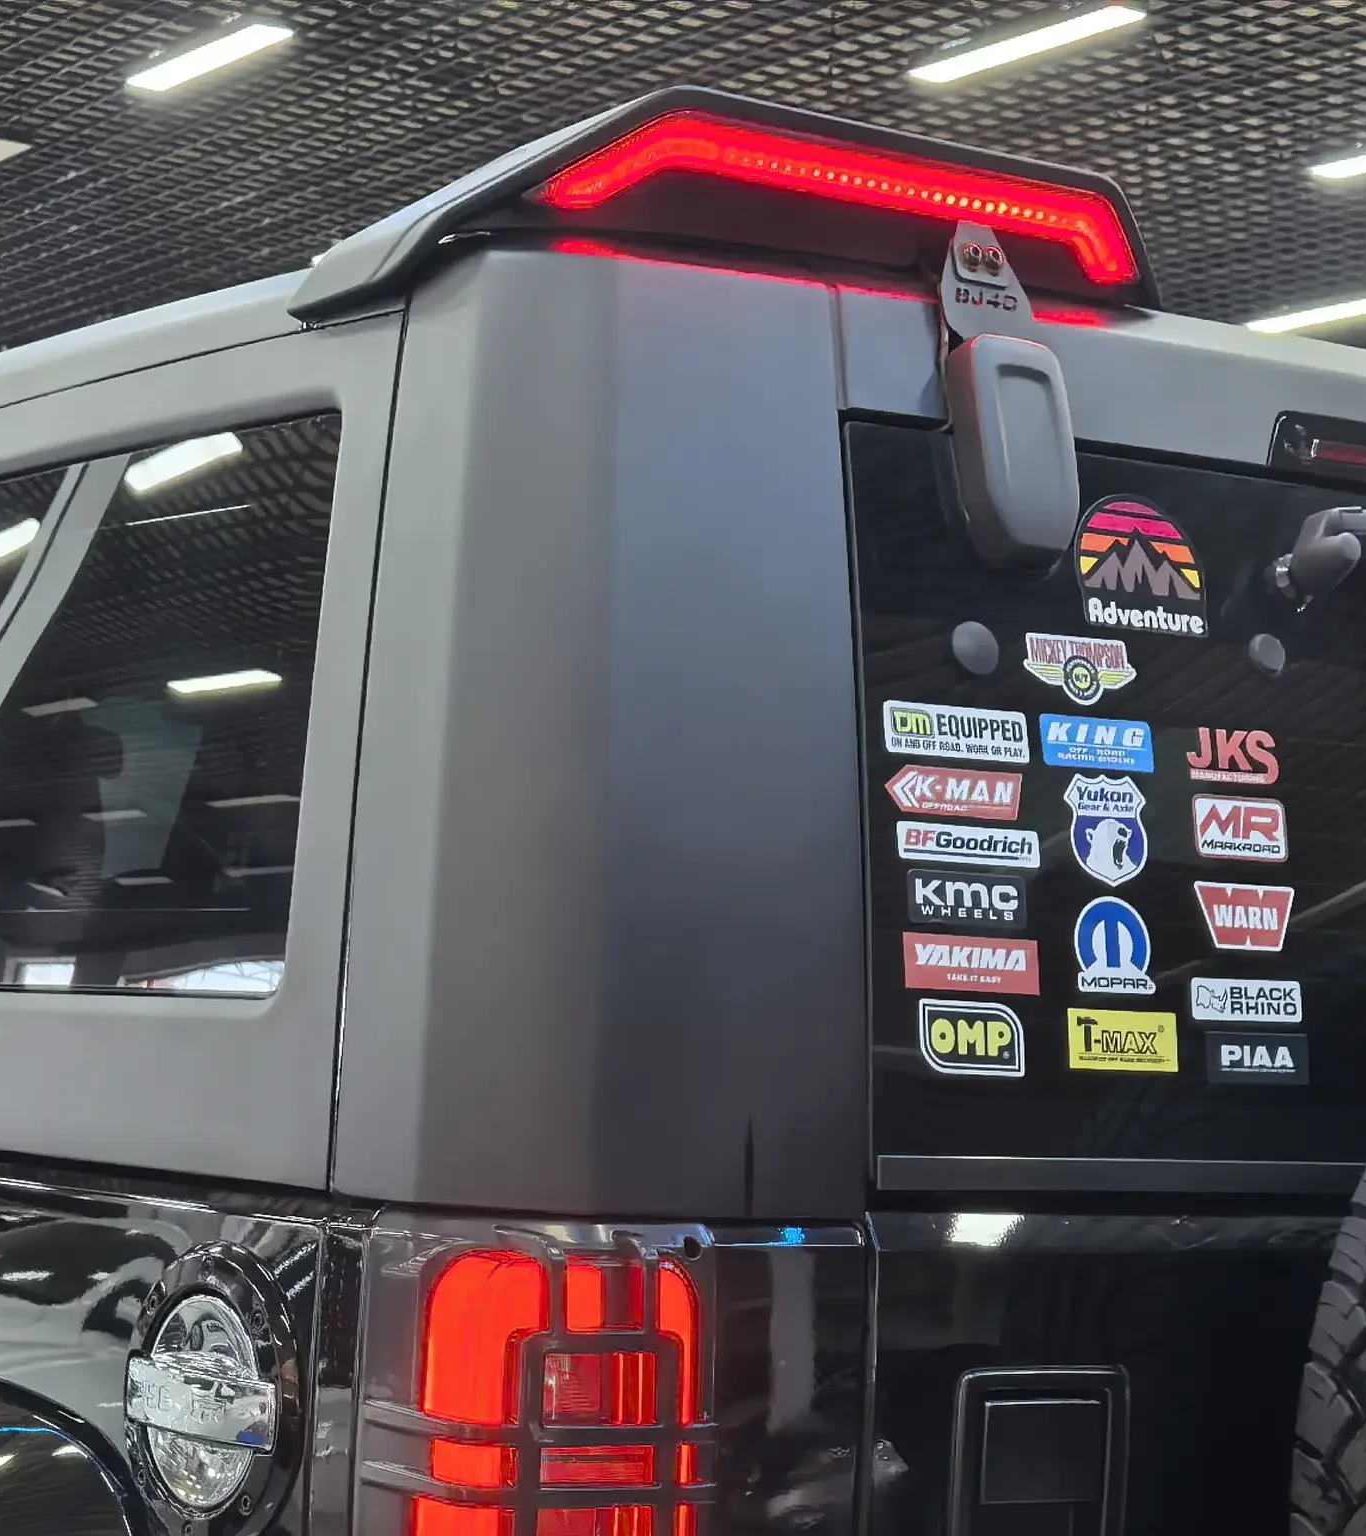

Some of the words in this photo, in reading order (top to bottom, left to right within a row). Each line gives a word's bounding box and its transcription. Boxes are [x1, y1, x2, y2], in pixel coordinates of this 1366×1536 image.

[1088, 597, 1205, 635] Adventure
[936, 713, 1023, 742] EQUIPPED
[1047, 722, 1144, 747] KING
[1186, 727, 1279, 784] JKS
[914, 774, 1014, 804] K-MAN
[1076, 785, 1134, 803] Yukon
[1078, 802, 1101, 811] Gear
[1200, 804, 1280, 842] MR
[905, 828, 1033, 855] BFGoodrich
[1201, 839, 1281, 853] MARKROAD
[921, 905, 1014, 920] WHEELS
[1213, 904, 1279, 930] WARN
[914, 943, 1027, 972] YAKIMA
[1081, 976, 1148, 990] MOPAR
[1230, 986, 1297, 1001] BLACK
[1230, 1002, 1297, 1016] RHINO
[931, 1018, 1011, 1056] OMP
[1077, 1016, 1158, 1054] T-MAX
[1220, 1044, 1294, 1067] PIAA
